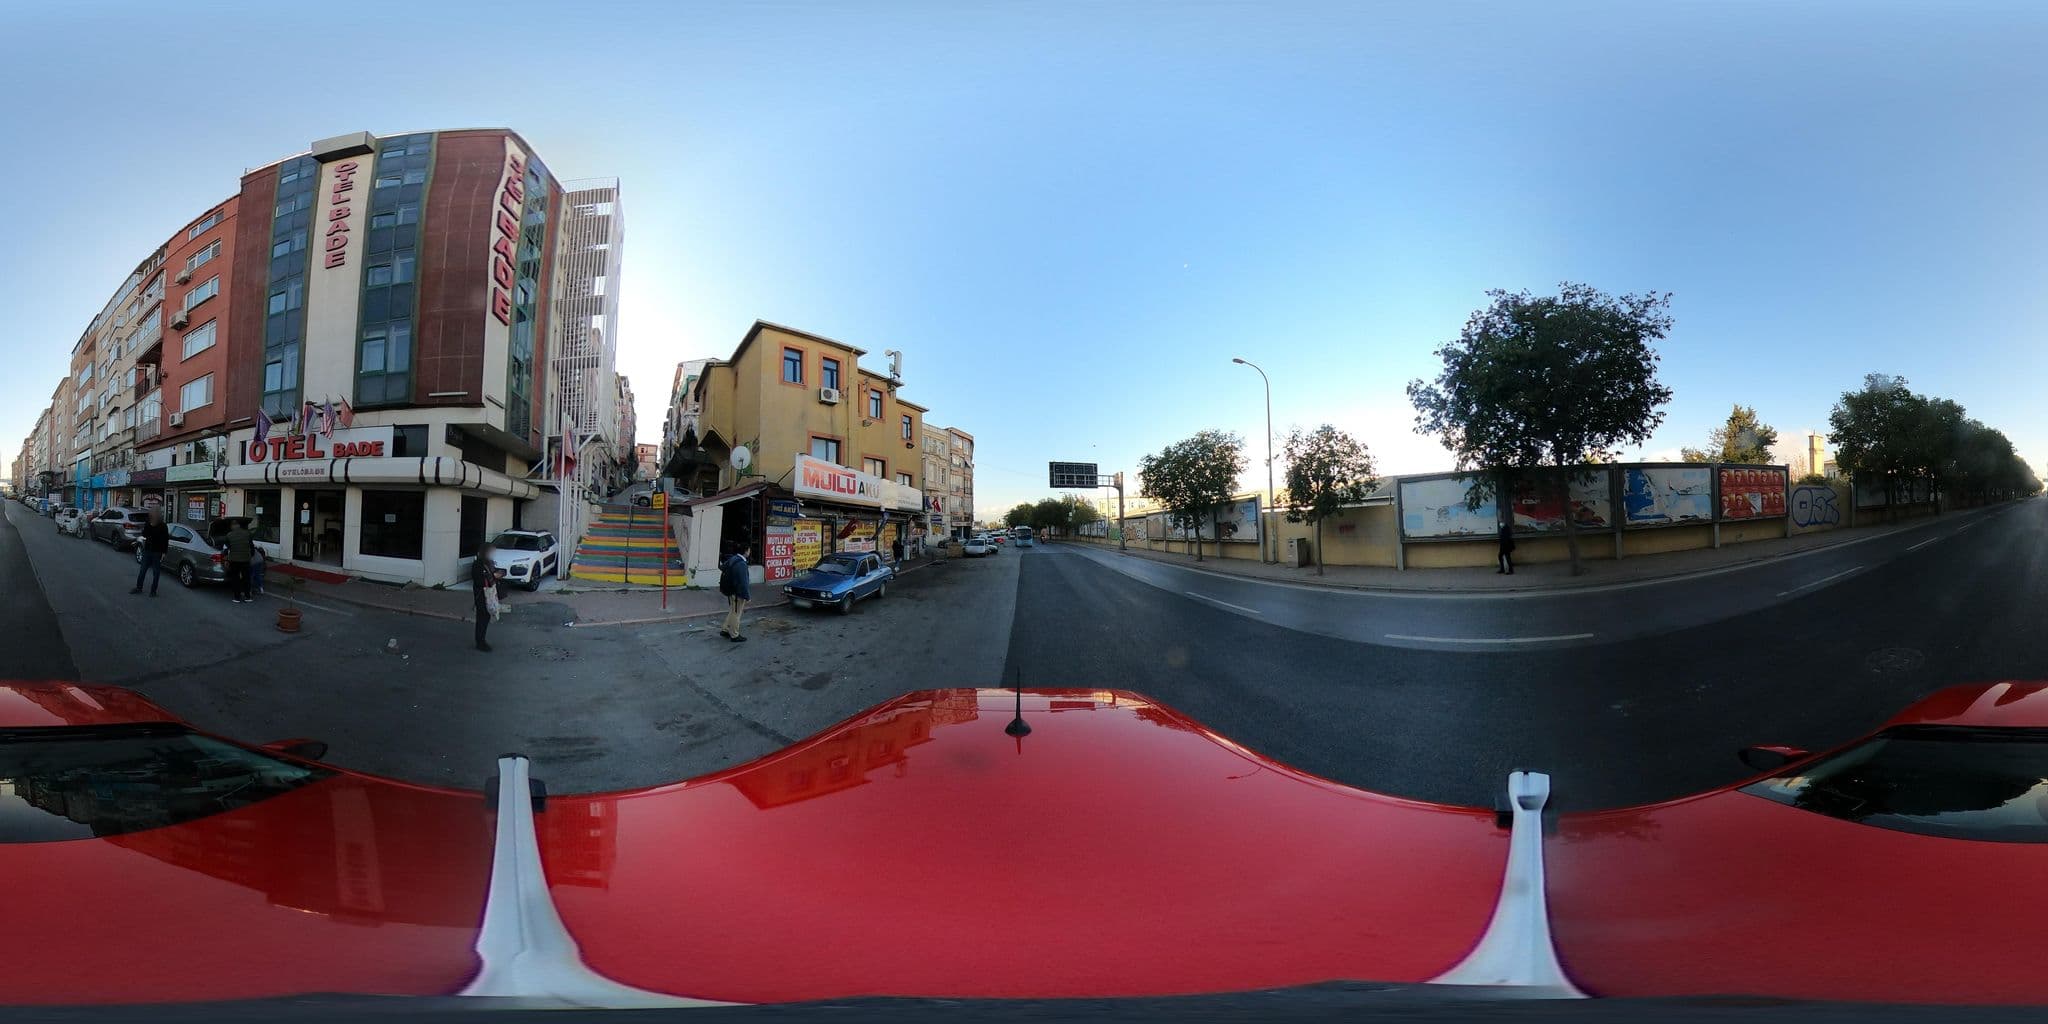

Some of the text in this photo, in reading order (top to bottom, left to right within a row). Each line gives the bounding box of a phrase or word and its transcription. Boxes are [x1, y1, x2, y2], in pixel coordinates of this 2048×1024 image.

[325, 161, 359, 270] OTEL BADE
[492, 209, 521, 327] BADE
[249, 433, 385, 463] OTEL BADE
[771, 545, 787, 556] 155
[775, 567, 786, 578] 50
